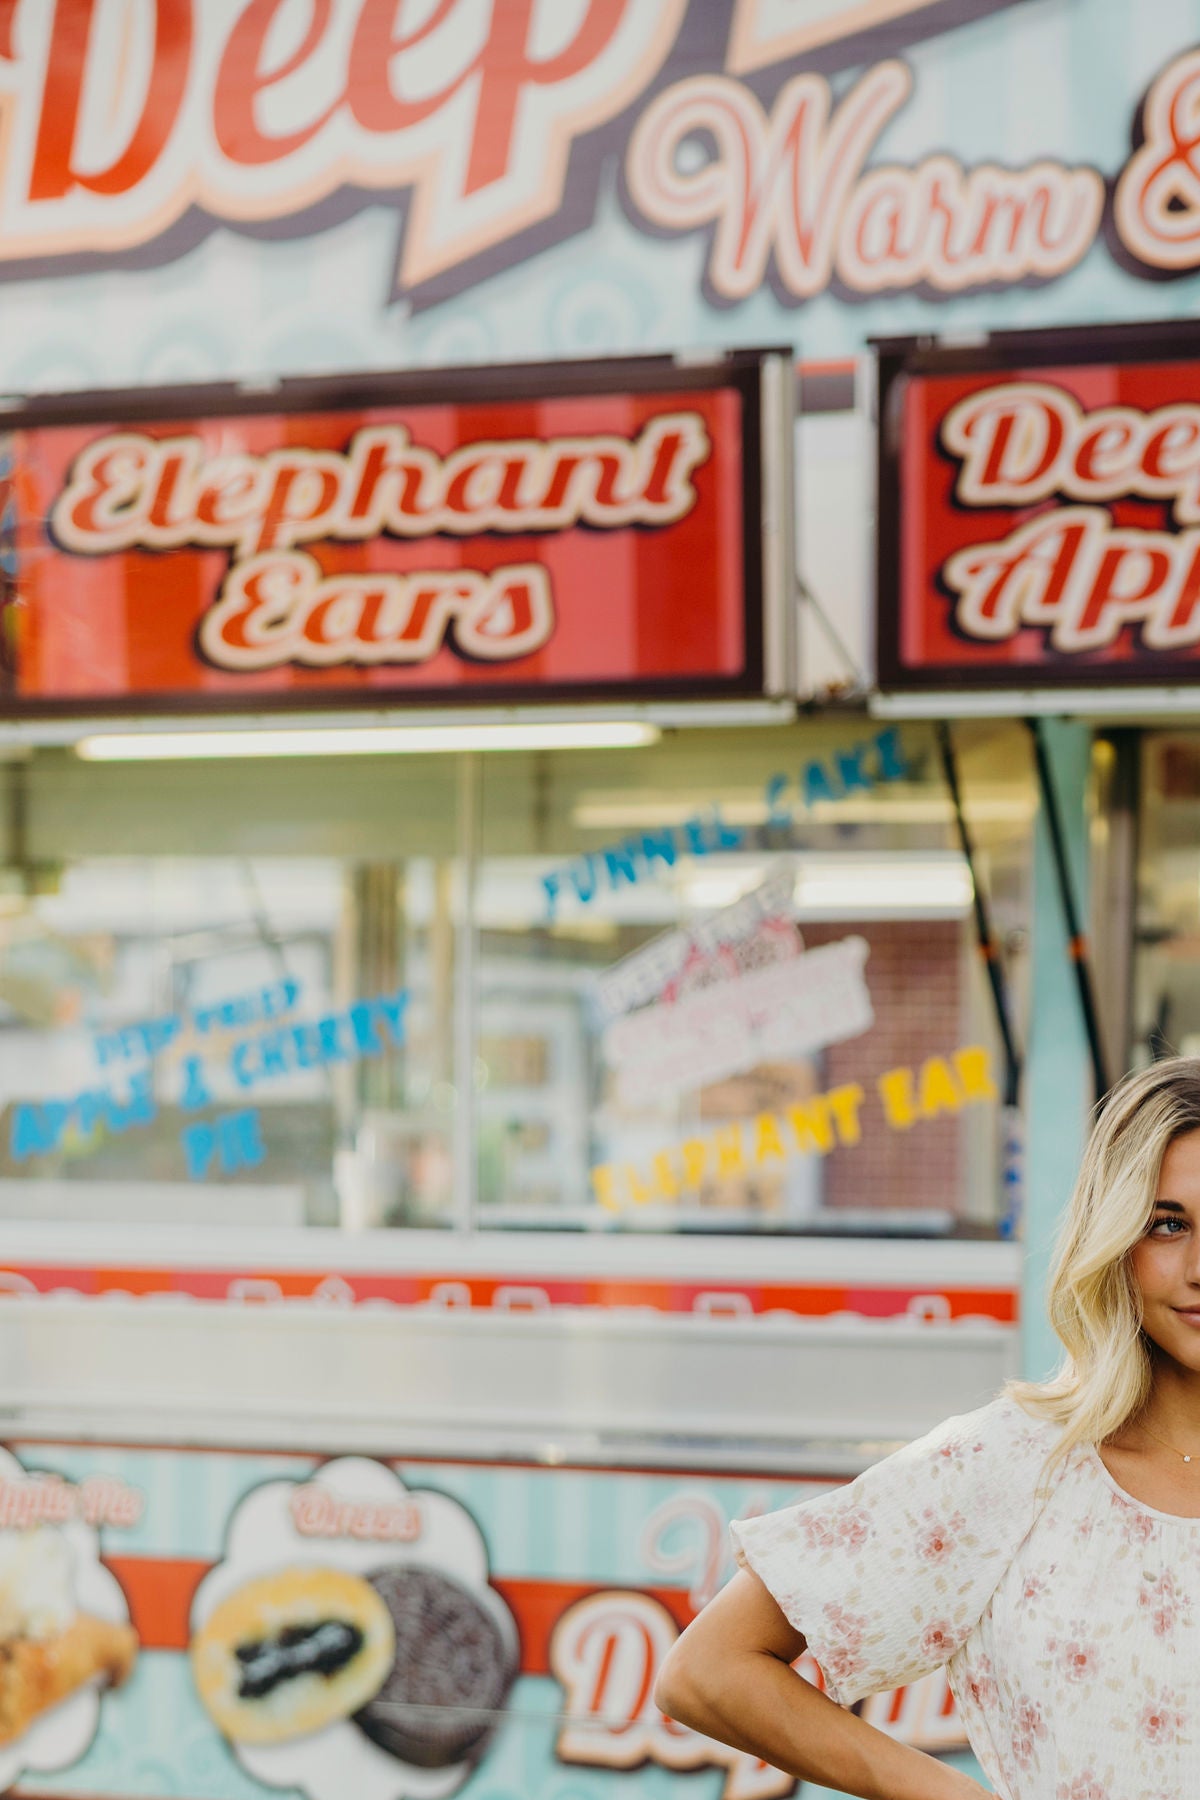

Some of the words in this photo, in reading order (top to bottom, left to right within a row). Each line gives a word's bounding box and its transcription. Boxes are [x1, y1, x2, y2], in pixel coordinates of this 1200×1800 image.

[627, 62, 1105, 298] Warm
[53, 410, 710, 555] Elephant
[200, 550, 555, 668] Ears
[540, 802, 744, 918] FUNNEL
[764, 727, 910, 826] CAKE
[592, 1083, 866, 1212] ELEPHANT
[878, 1047, 994, 1128] EAR
[0, 1477, 78, 1530] pple
